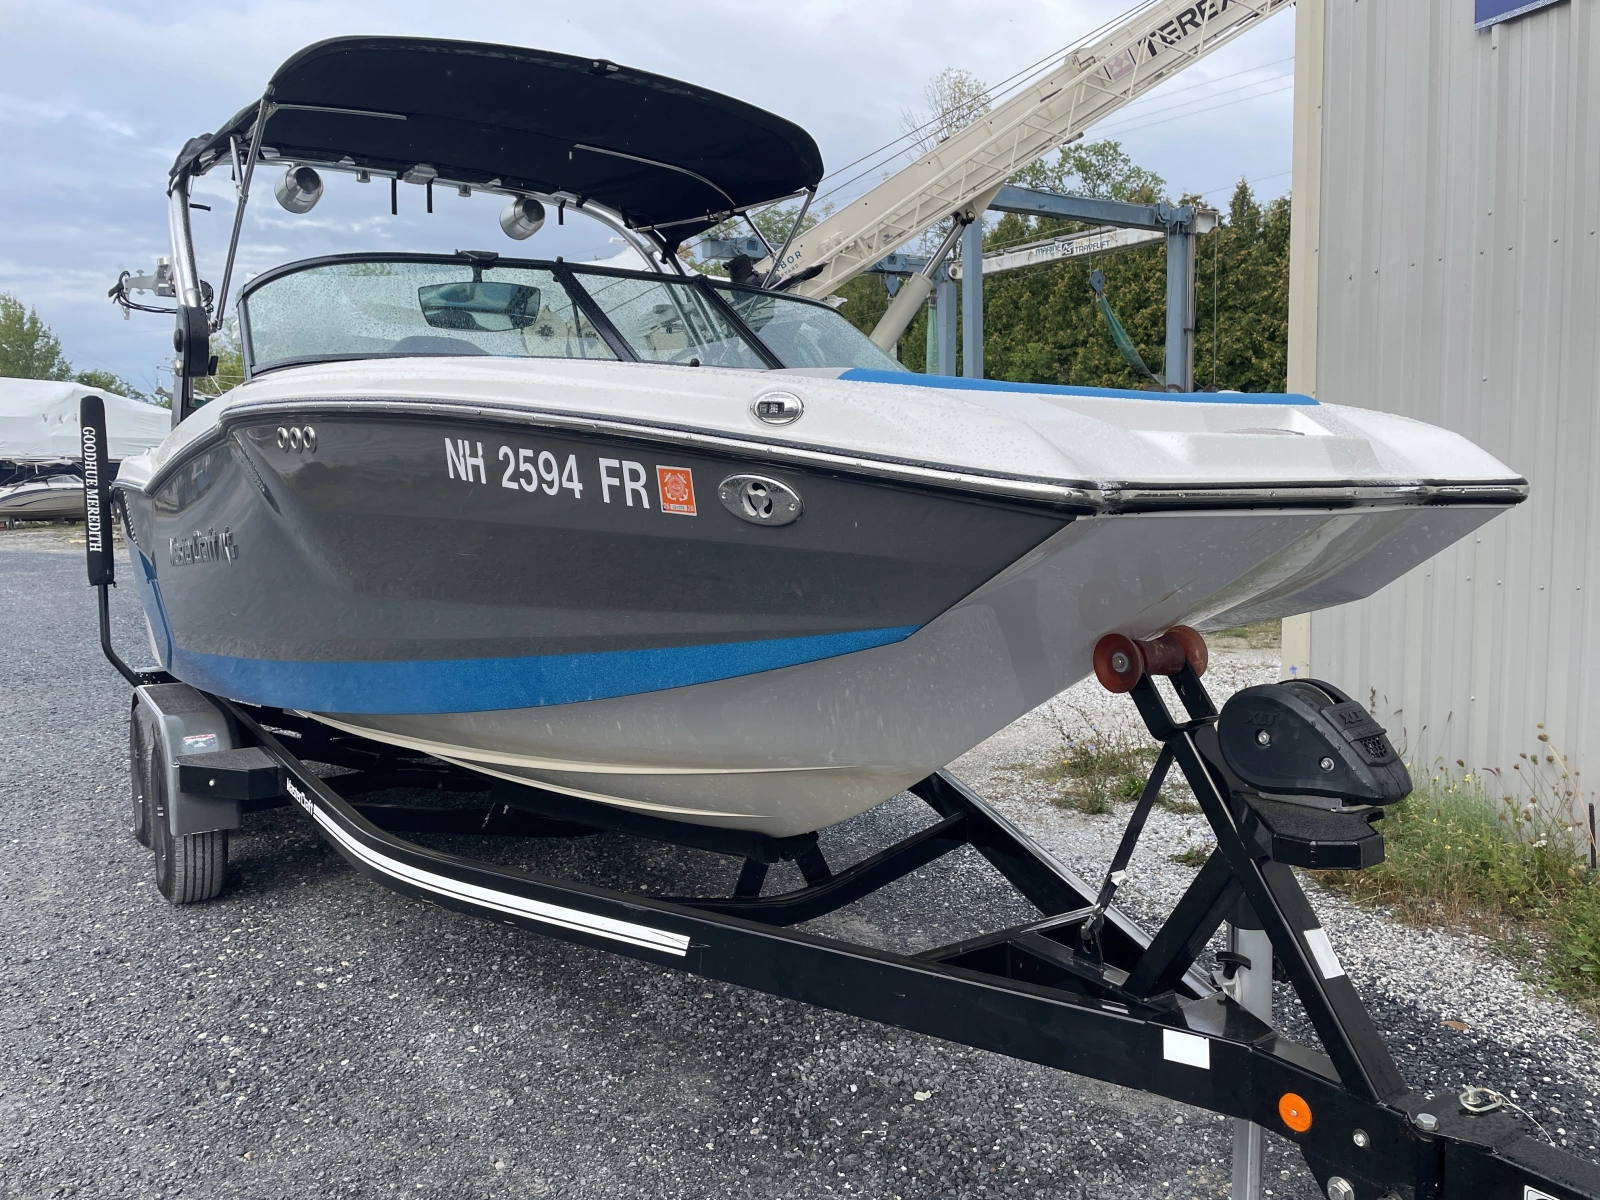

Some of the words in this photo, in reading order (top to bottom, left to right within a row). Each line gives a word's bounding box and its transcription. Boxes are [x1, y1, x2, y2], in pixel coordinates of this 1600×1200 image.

[776, 250, 803, 272] BOR
[1035, 243, 1061, 256] MARINE
[82, 426, 98, 487] GOODHUE
[444, 437, 487, 485] NH
[498, 445, 584, 499] 2594
[598, 457, 651, 509] FR
[86, 488, 103, 553] MEREDITH
[1244, 711, 1280, 726] XLT
[1338, 710, 1364, 725] XLT
[286, 777, 314, 816] MasterCraft
